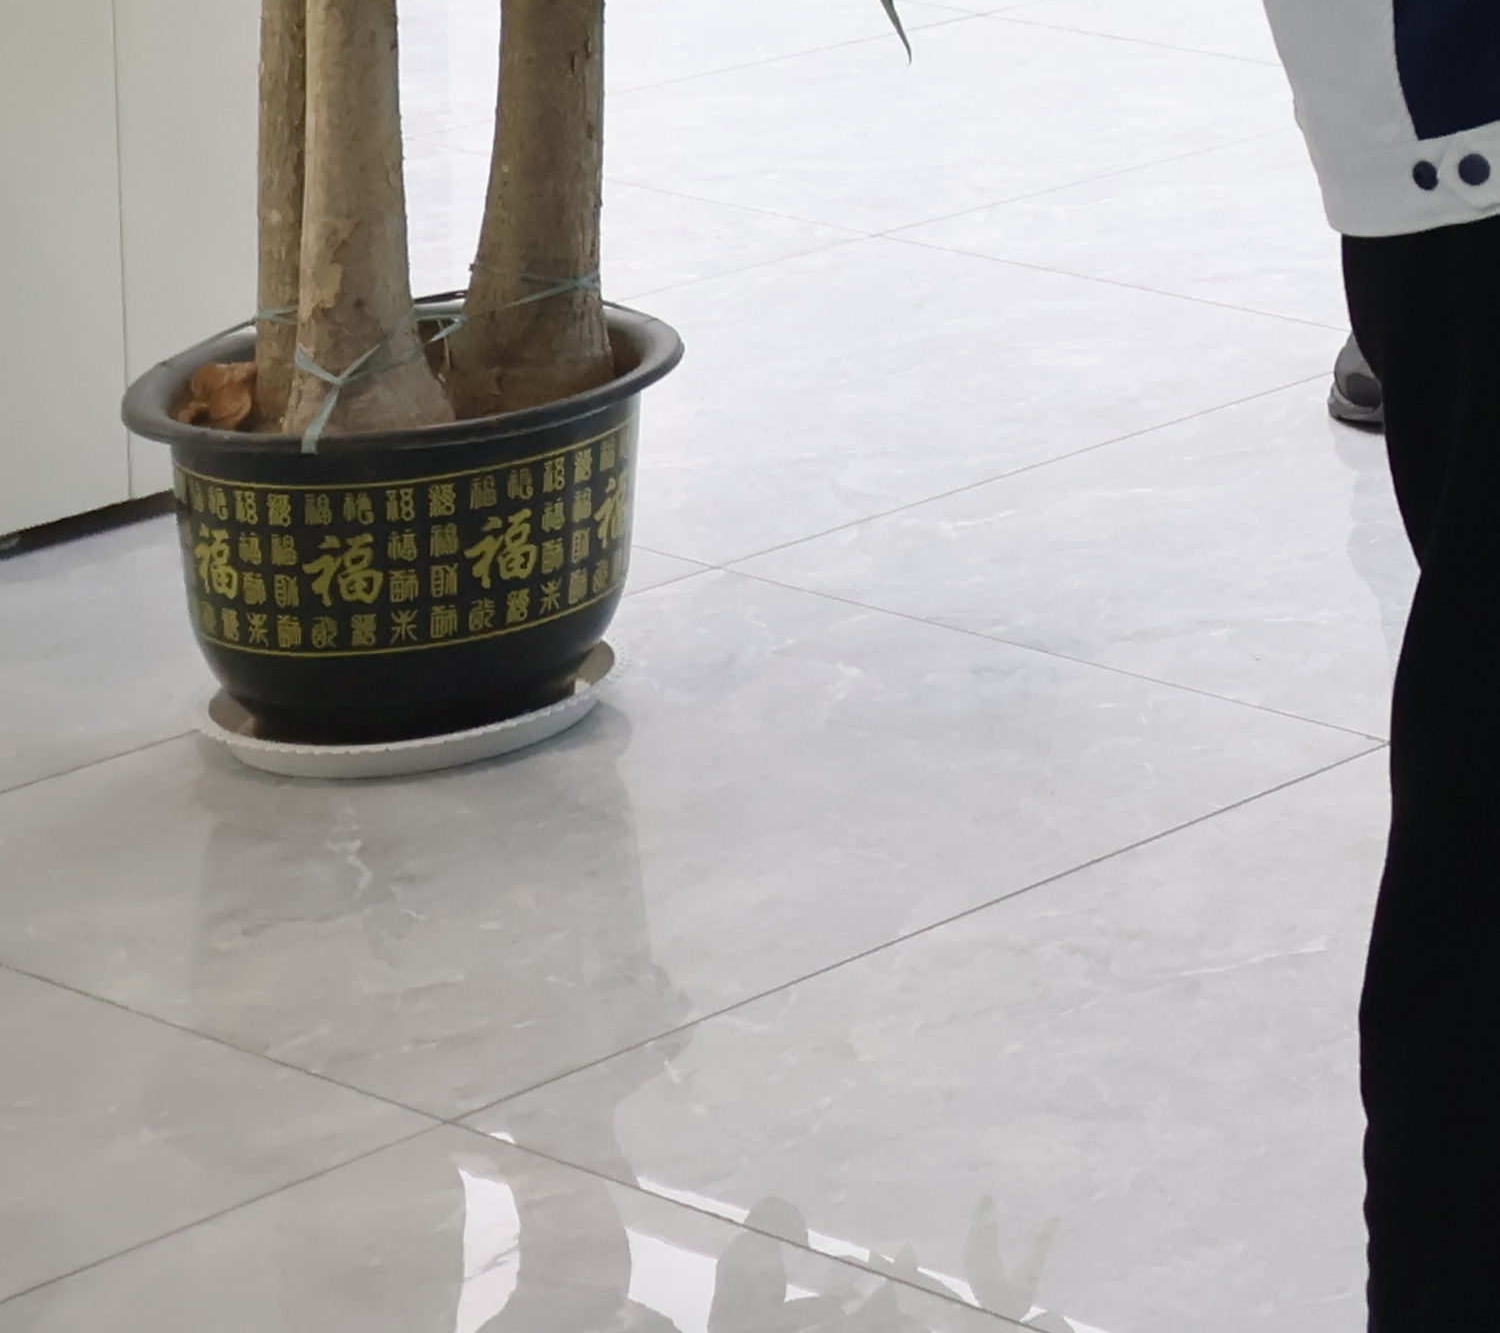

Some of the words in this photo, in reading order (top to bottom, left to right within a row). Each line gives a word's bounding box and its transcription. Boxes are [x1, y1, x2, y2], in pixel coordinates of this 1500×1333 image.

[194, 523, 239, 599] 福
[302, 531, 384, 607] 福
[464, 508, 539, 589] 福
